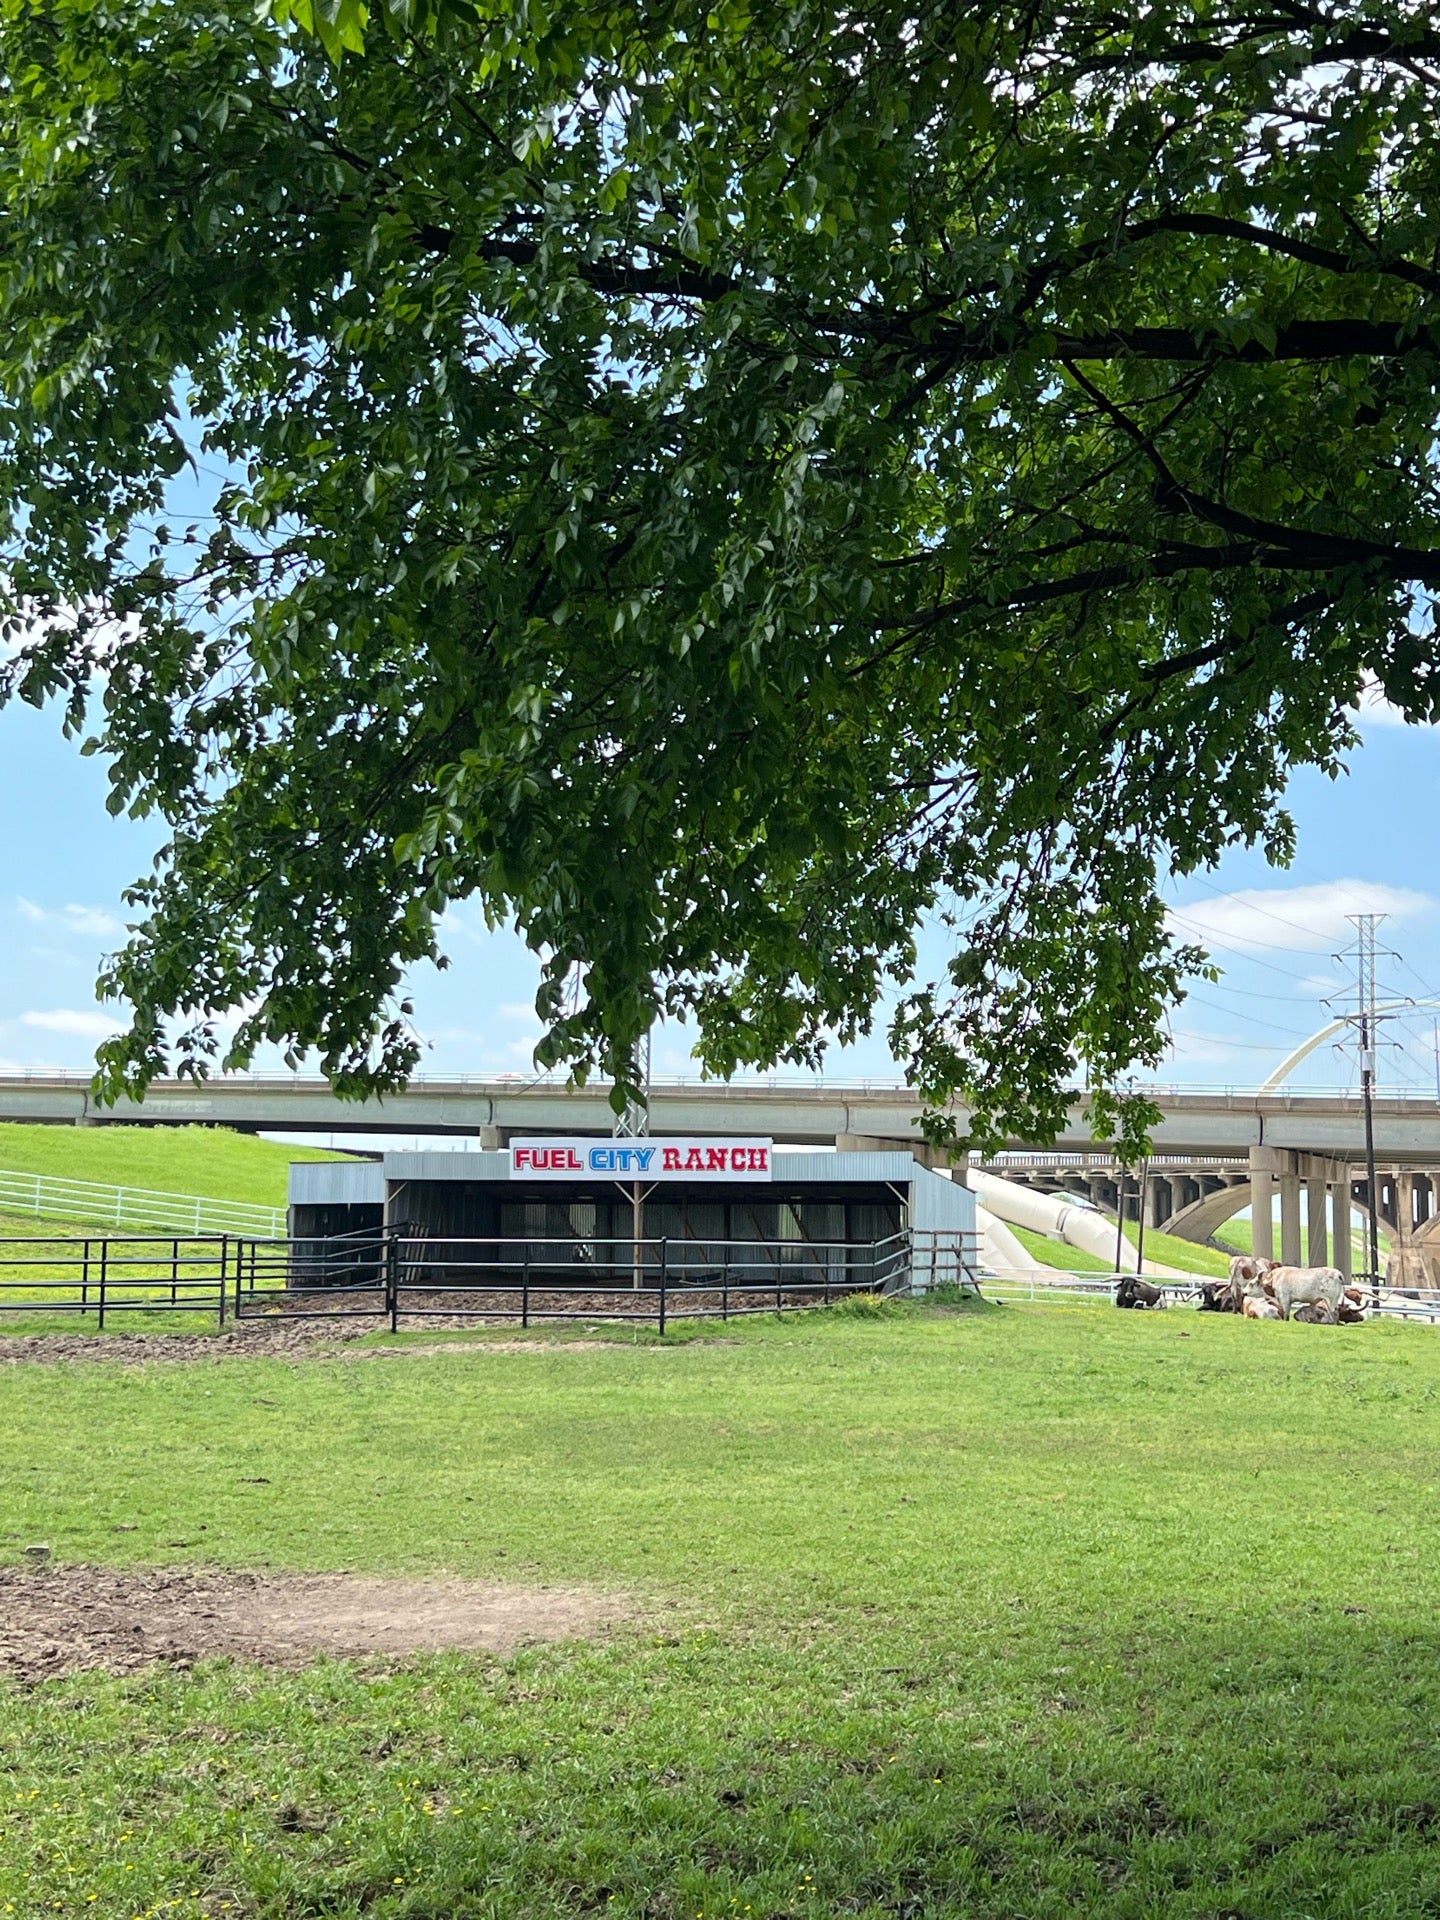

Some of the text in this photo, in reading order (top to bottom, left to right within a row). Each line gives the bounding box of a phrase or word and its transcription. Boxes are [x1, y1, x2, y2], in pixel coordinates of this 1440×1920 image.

[514, 1147, 768, 1171] FUEL CITY RANCH
